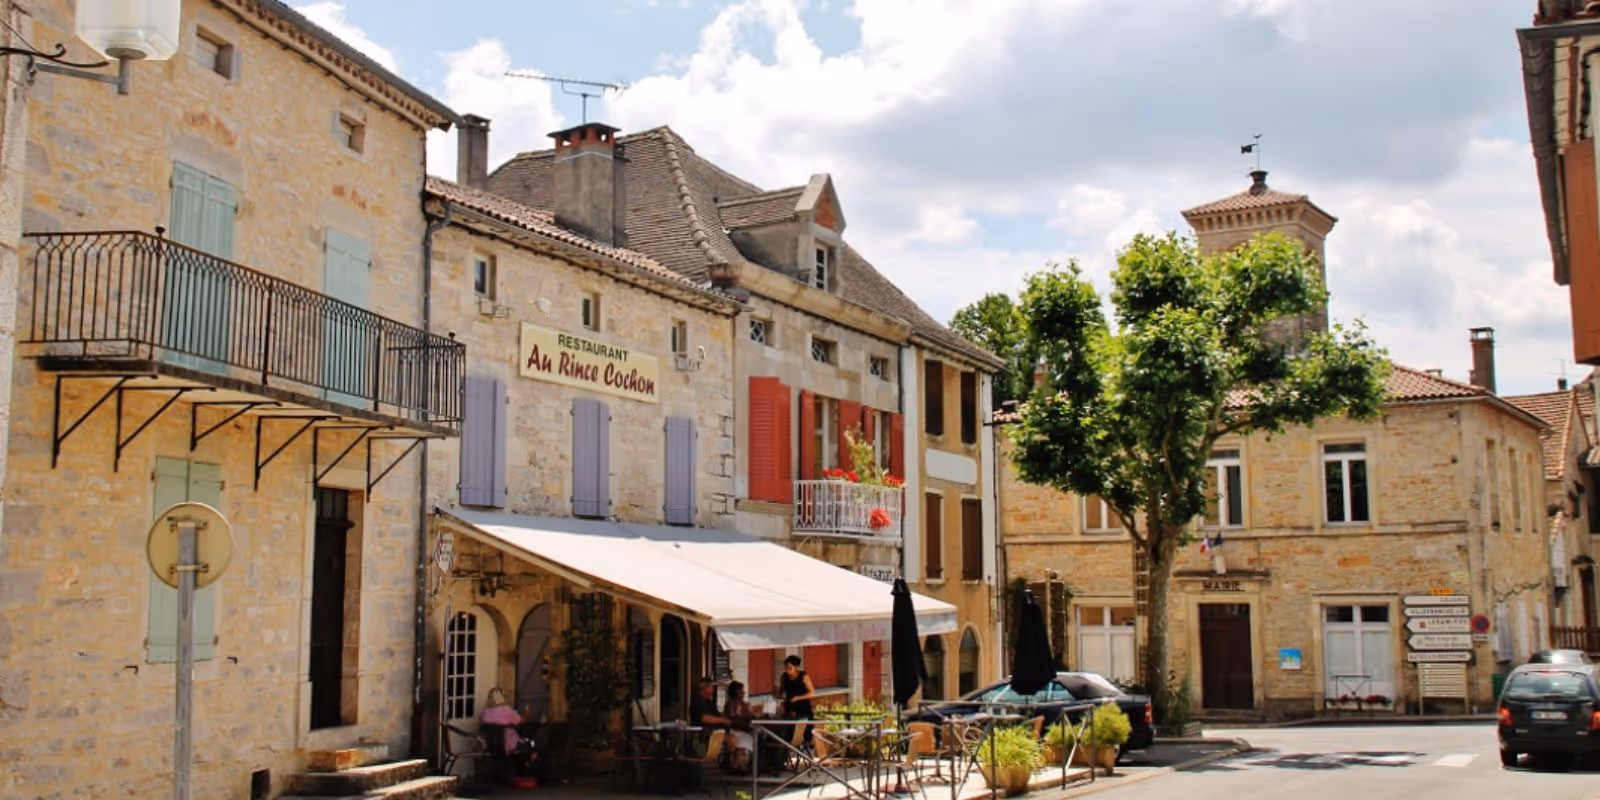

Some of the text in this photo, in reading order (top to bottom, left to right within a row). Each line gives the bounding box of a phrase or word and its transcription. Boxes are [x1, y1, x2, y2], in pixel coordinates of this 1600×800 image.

[558, 334, 629, 362] RESTAURANT
[527, 344, 655, 395] Au Rince Cochon
[1203, 581, 1243, 591] MAIRIE
